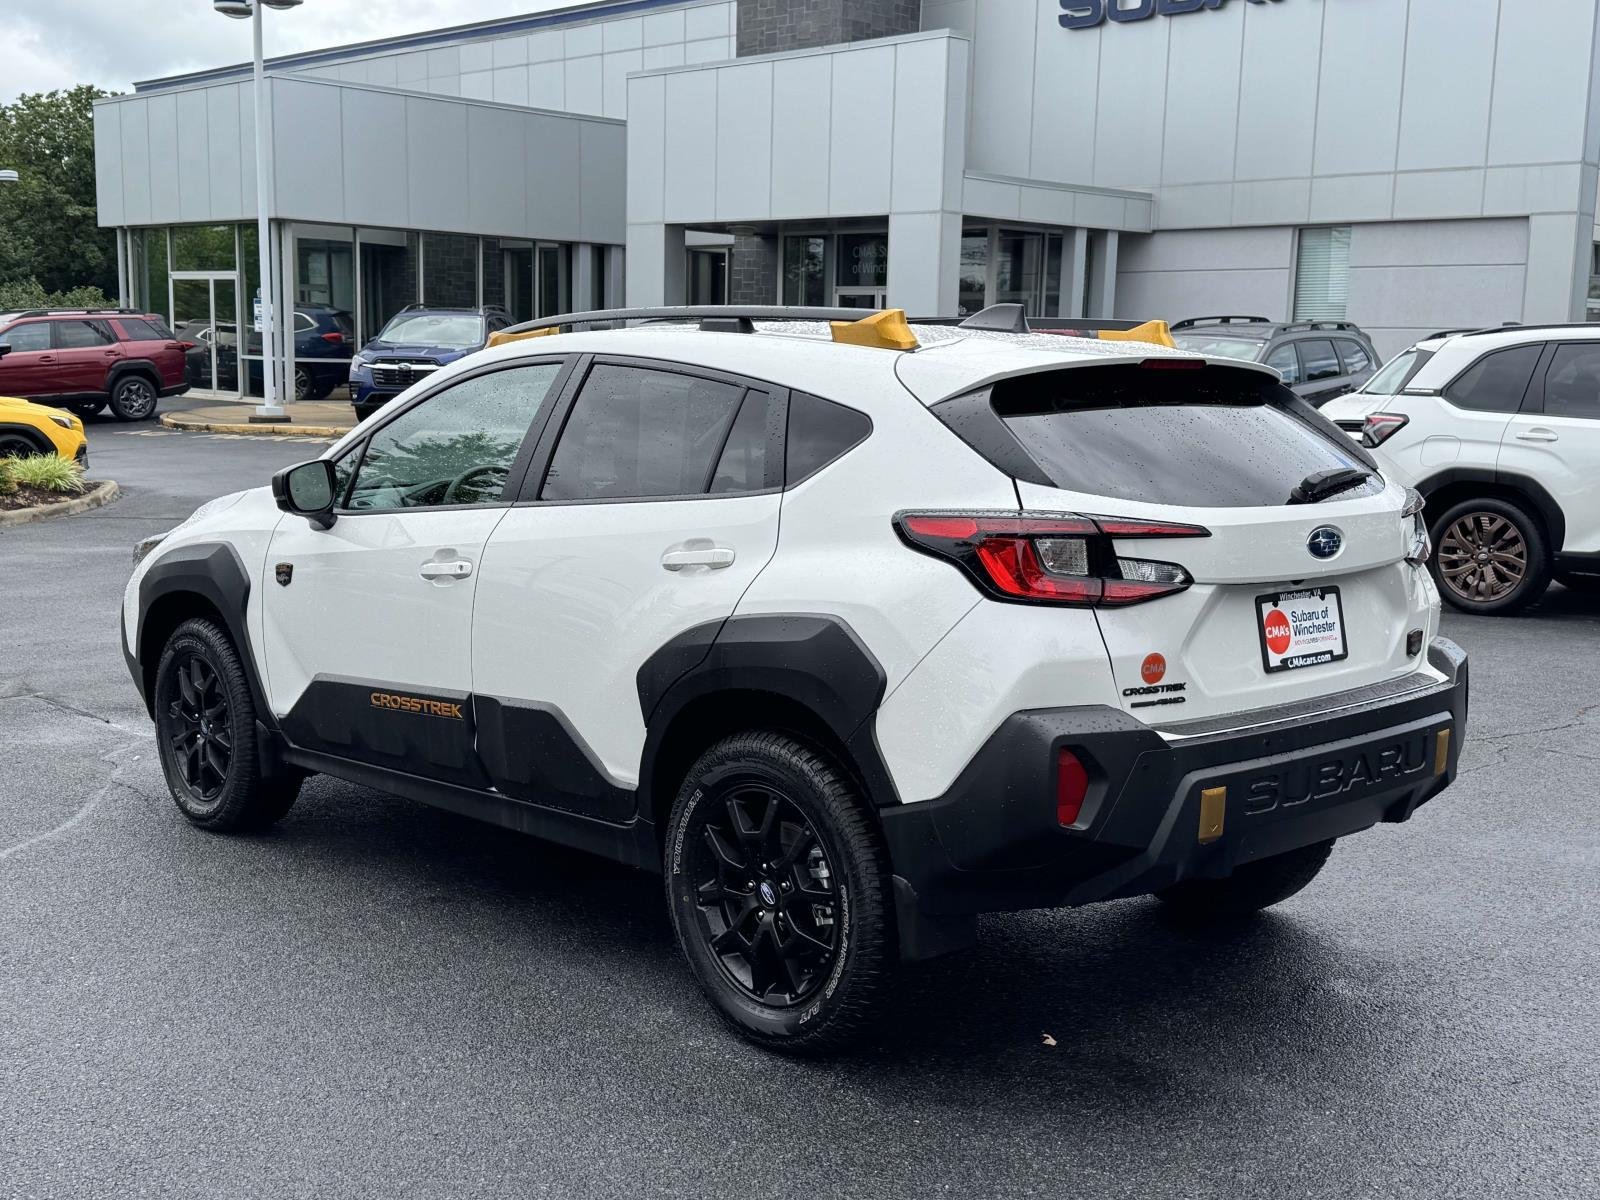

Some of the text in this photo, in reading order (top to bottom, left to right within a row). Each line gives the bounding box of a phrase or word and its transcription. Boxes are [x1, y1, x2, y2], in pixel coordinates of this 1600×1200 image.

[1313, 588, 1321, 596] VA
[1291, 606, 1328, 623] Subaru of
[1266, 625, 1290, 638] CMA's
[1292, 621, 1335, 637] Winchester
[1287, 653, 1331, 668] CMAcars.com
[1144, 664, 1164, 674] CMA
[1122, 682, 1187, 697] CROSSTREK
[370, 692, 463, 719] CROSSTREK
[1242, 734, 1428, 816] SUBARU
